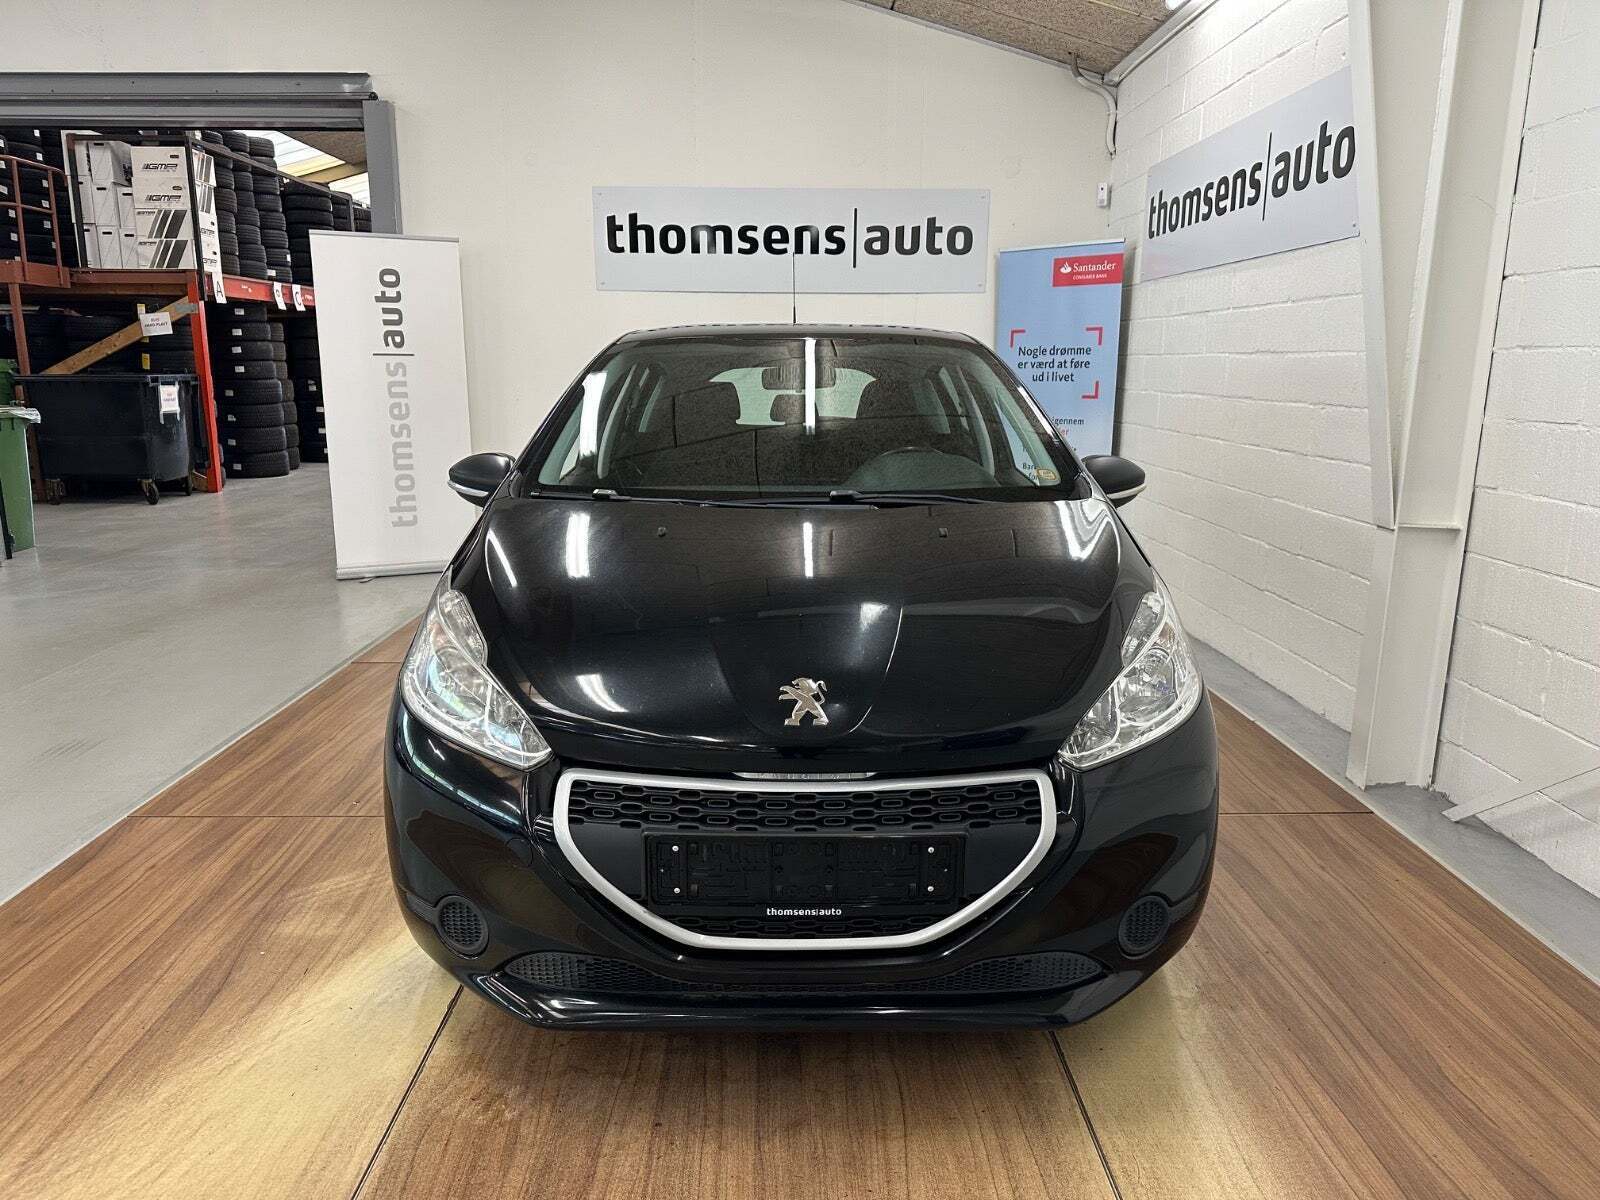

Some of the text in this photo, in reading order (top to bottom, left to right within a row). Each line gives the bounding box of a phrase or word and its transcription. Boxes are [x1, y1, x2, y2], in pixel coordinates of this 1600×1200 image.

[1073, 260, 1115, 272] Santander
[216, 280, 224, 298] A
[1018, 345, 1092, 359] Nogle drømme
[1017, 358, 1091, 369] er værd at føre
[1032, 371, 1045, 382] ud
[1051, 371, 1075, 382] livet
